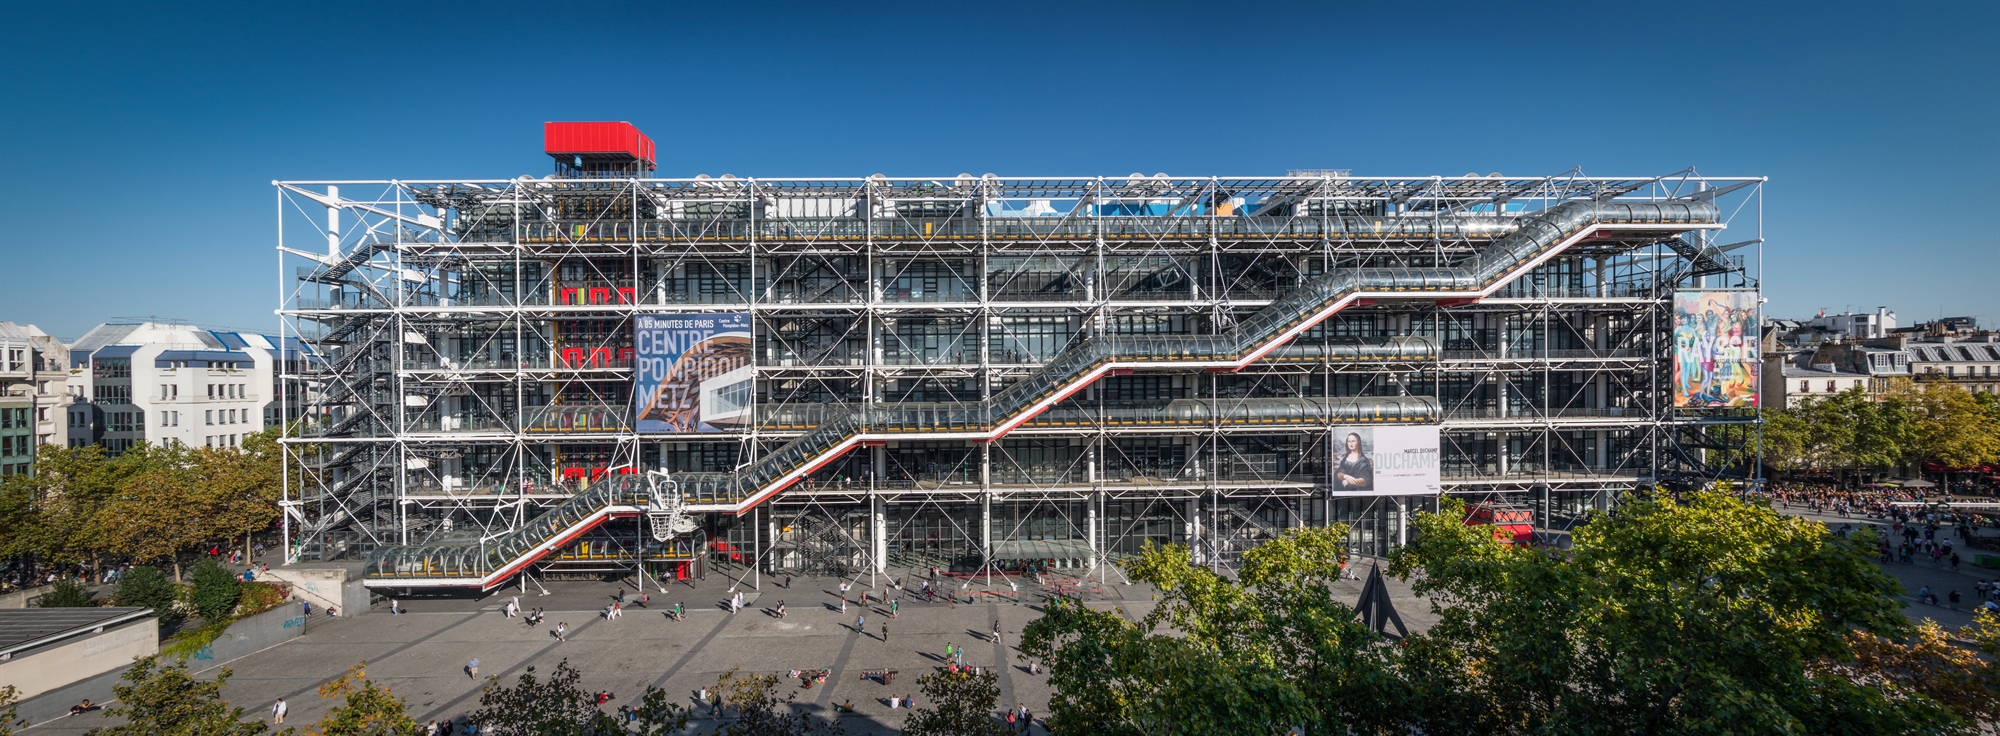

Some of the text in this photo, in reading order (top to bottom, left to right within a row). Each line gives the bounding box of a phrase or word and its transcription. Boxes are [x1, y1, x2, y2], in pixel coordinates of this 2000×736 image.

[645, 320, 652, 328] 85
[654, 320, 683, 328] MINUTES
[684, 320, 693, 328] DE
[694, 320, 714, 328] PARIS
[638, 330, 714, 354] CENTRE
[1678, 335, 1758, 363] RAYSSE
[638, 356, 745, 381] POMPIDOU
[640, 384, 691, 409] METZ
[1375, 452, 1439, 470] DUCHAMP
[82, 636, 112, 651] Atelier
